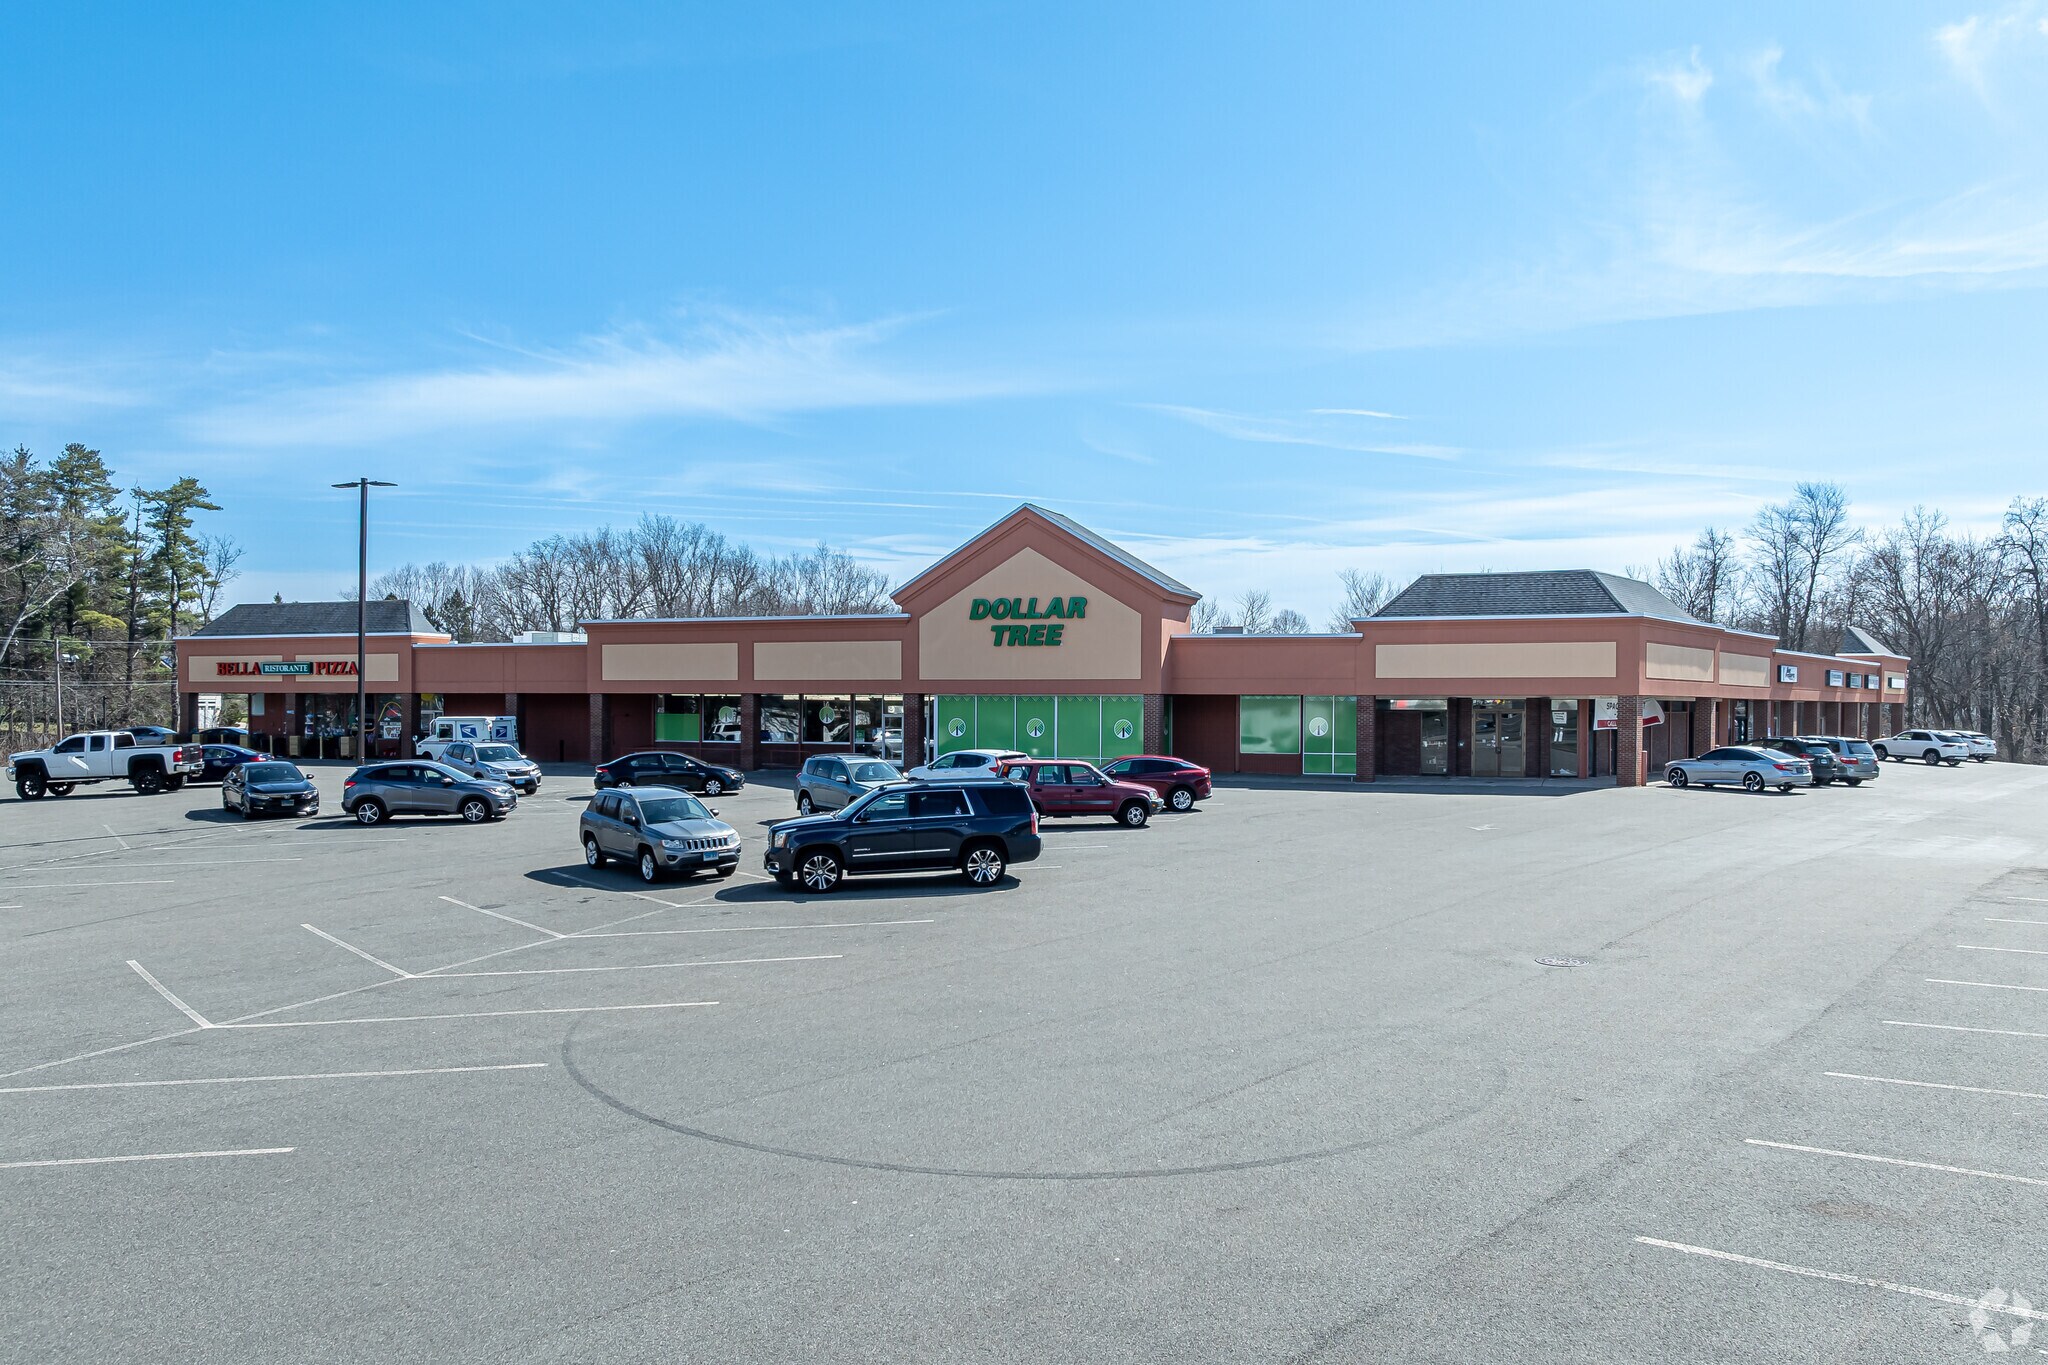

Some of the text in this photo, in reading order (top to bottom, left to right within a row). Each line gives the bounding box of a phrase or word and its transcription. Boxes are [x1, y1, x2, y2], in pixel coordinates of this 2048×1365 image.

[969, 597, 1087, 620] DOLLAR
[991, 624, 1064, 647] TREE
[216, 661, 359, 676] BELLA RISTORANTE PIZZA
[1606, 702, 1618, 710] SPAC
